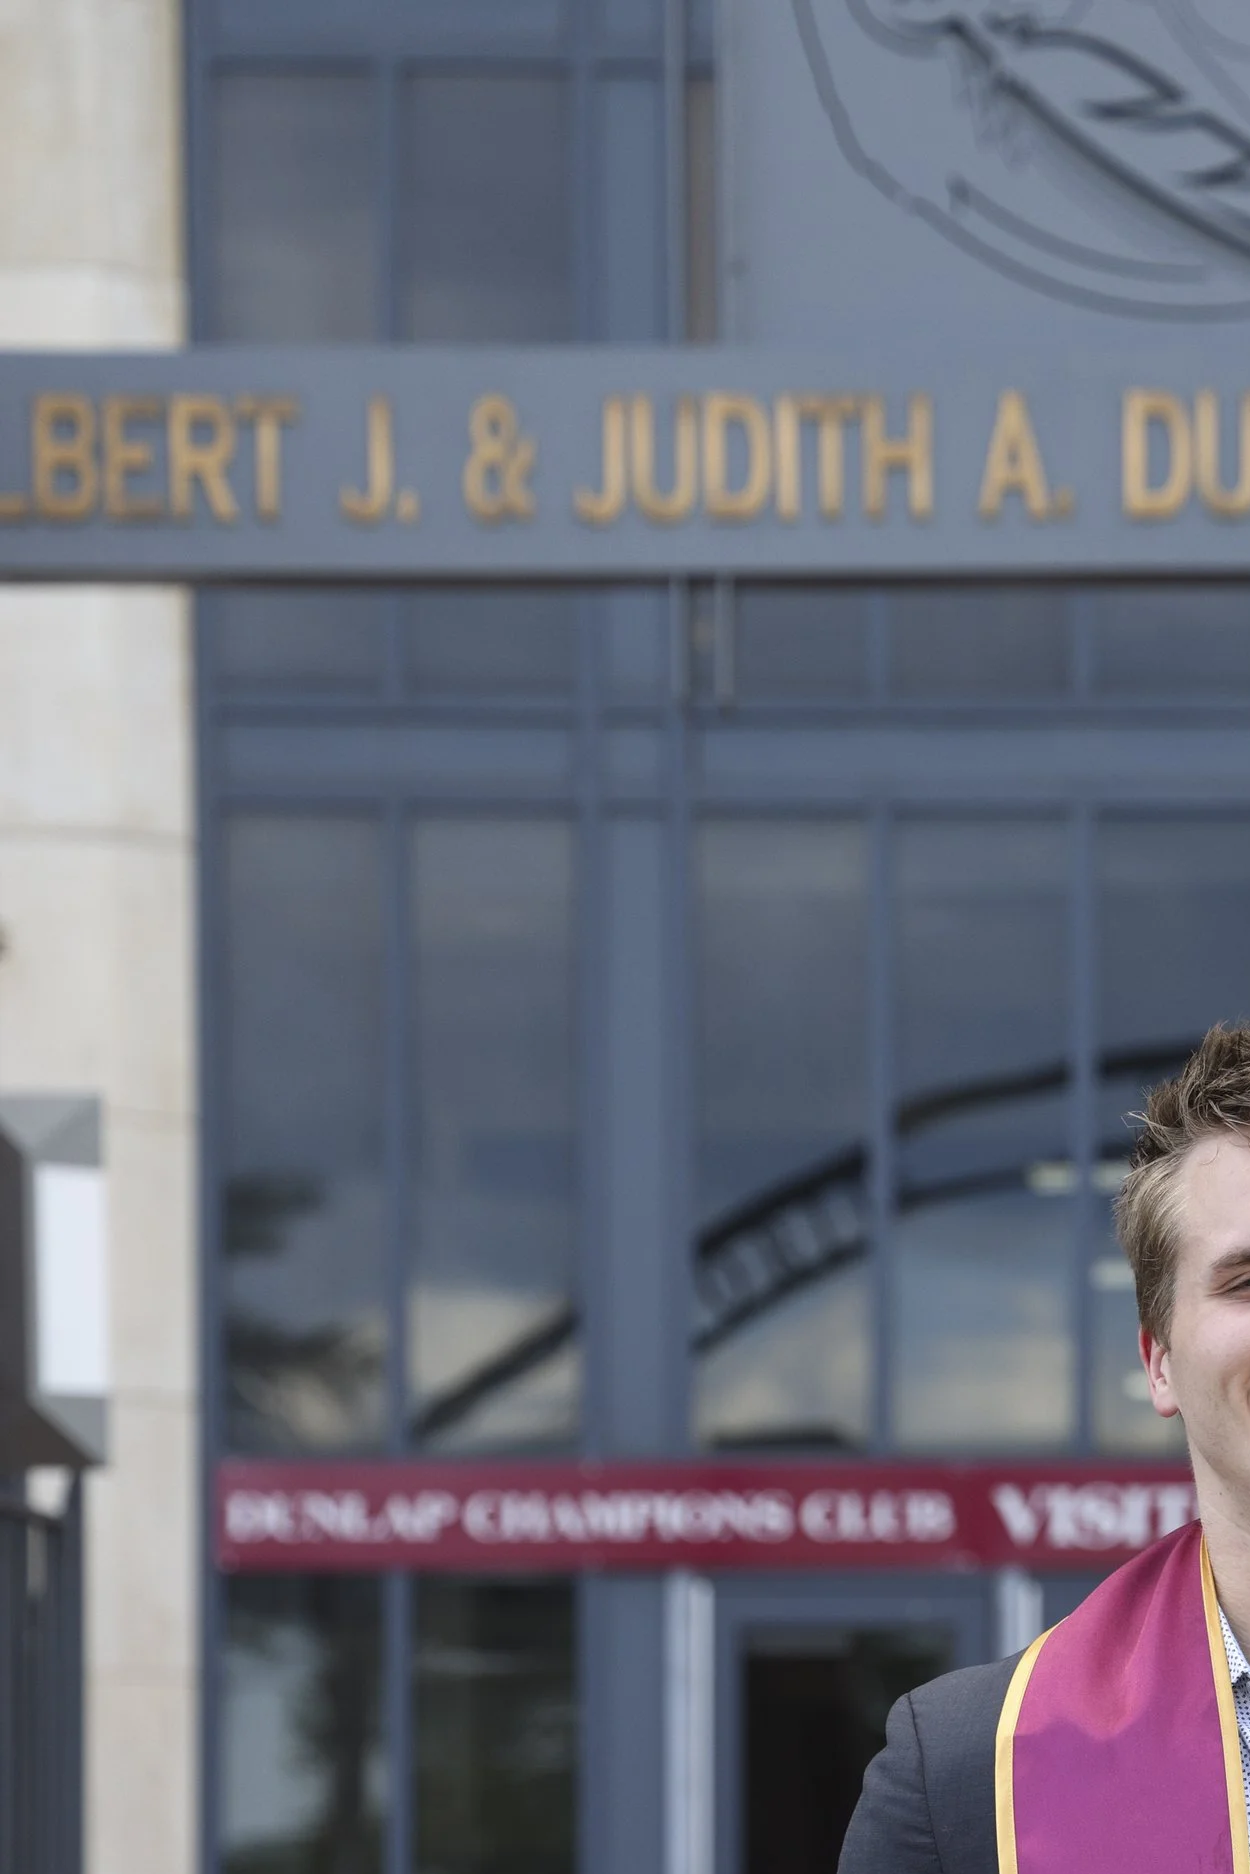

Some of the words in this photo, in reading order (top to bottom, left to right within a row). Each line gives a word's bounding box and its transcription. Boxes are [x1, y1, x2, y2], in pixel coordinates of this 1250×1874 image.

[339, 392, 420, 526] J.
[461, 390, 538, 524] &
[573, 388, 934, 526] JUDITH
[978, 386, 1076, 522] A.
[222, 1487, 461, 1544] DUNLAP
[461, 1487, 796, 1544] CHAMPIONS
[798, 1487, 958, 1544] CLUB
[989, 1481, 1199, 1551] VISIT
